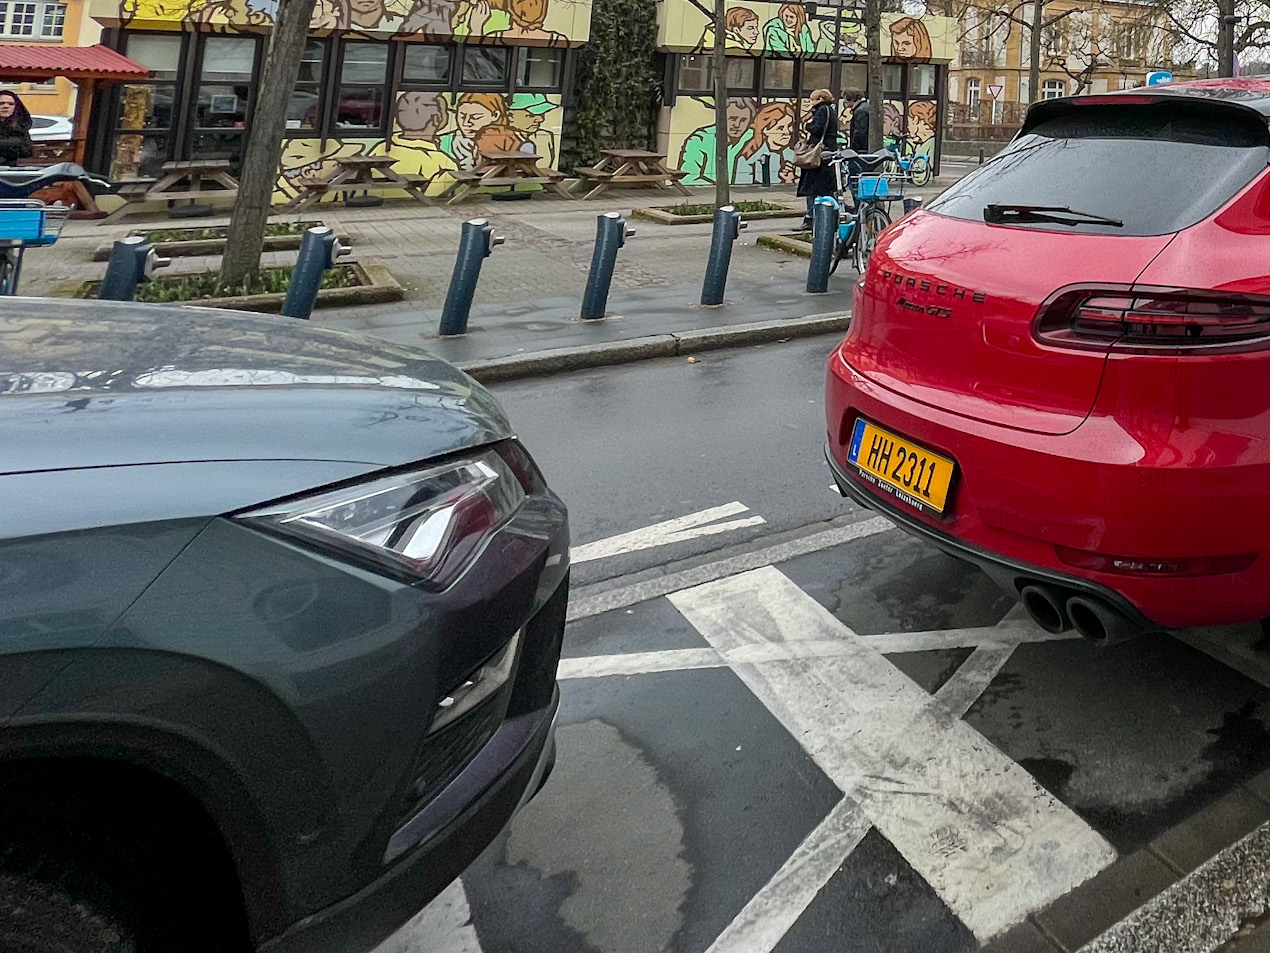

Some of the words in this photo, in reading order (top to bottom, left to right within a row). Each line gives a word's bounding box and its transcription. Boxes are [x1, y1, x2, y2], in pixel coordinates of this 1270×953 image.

[883, 270, 987, 304] PORSCHE
[926, 306, 952, 318] GTS
[852, 444, 858, 456] L
[867, 434, 894, 475] HH
[892, 446, 936, 498] 2311
